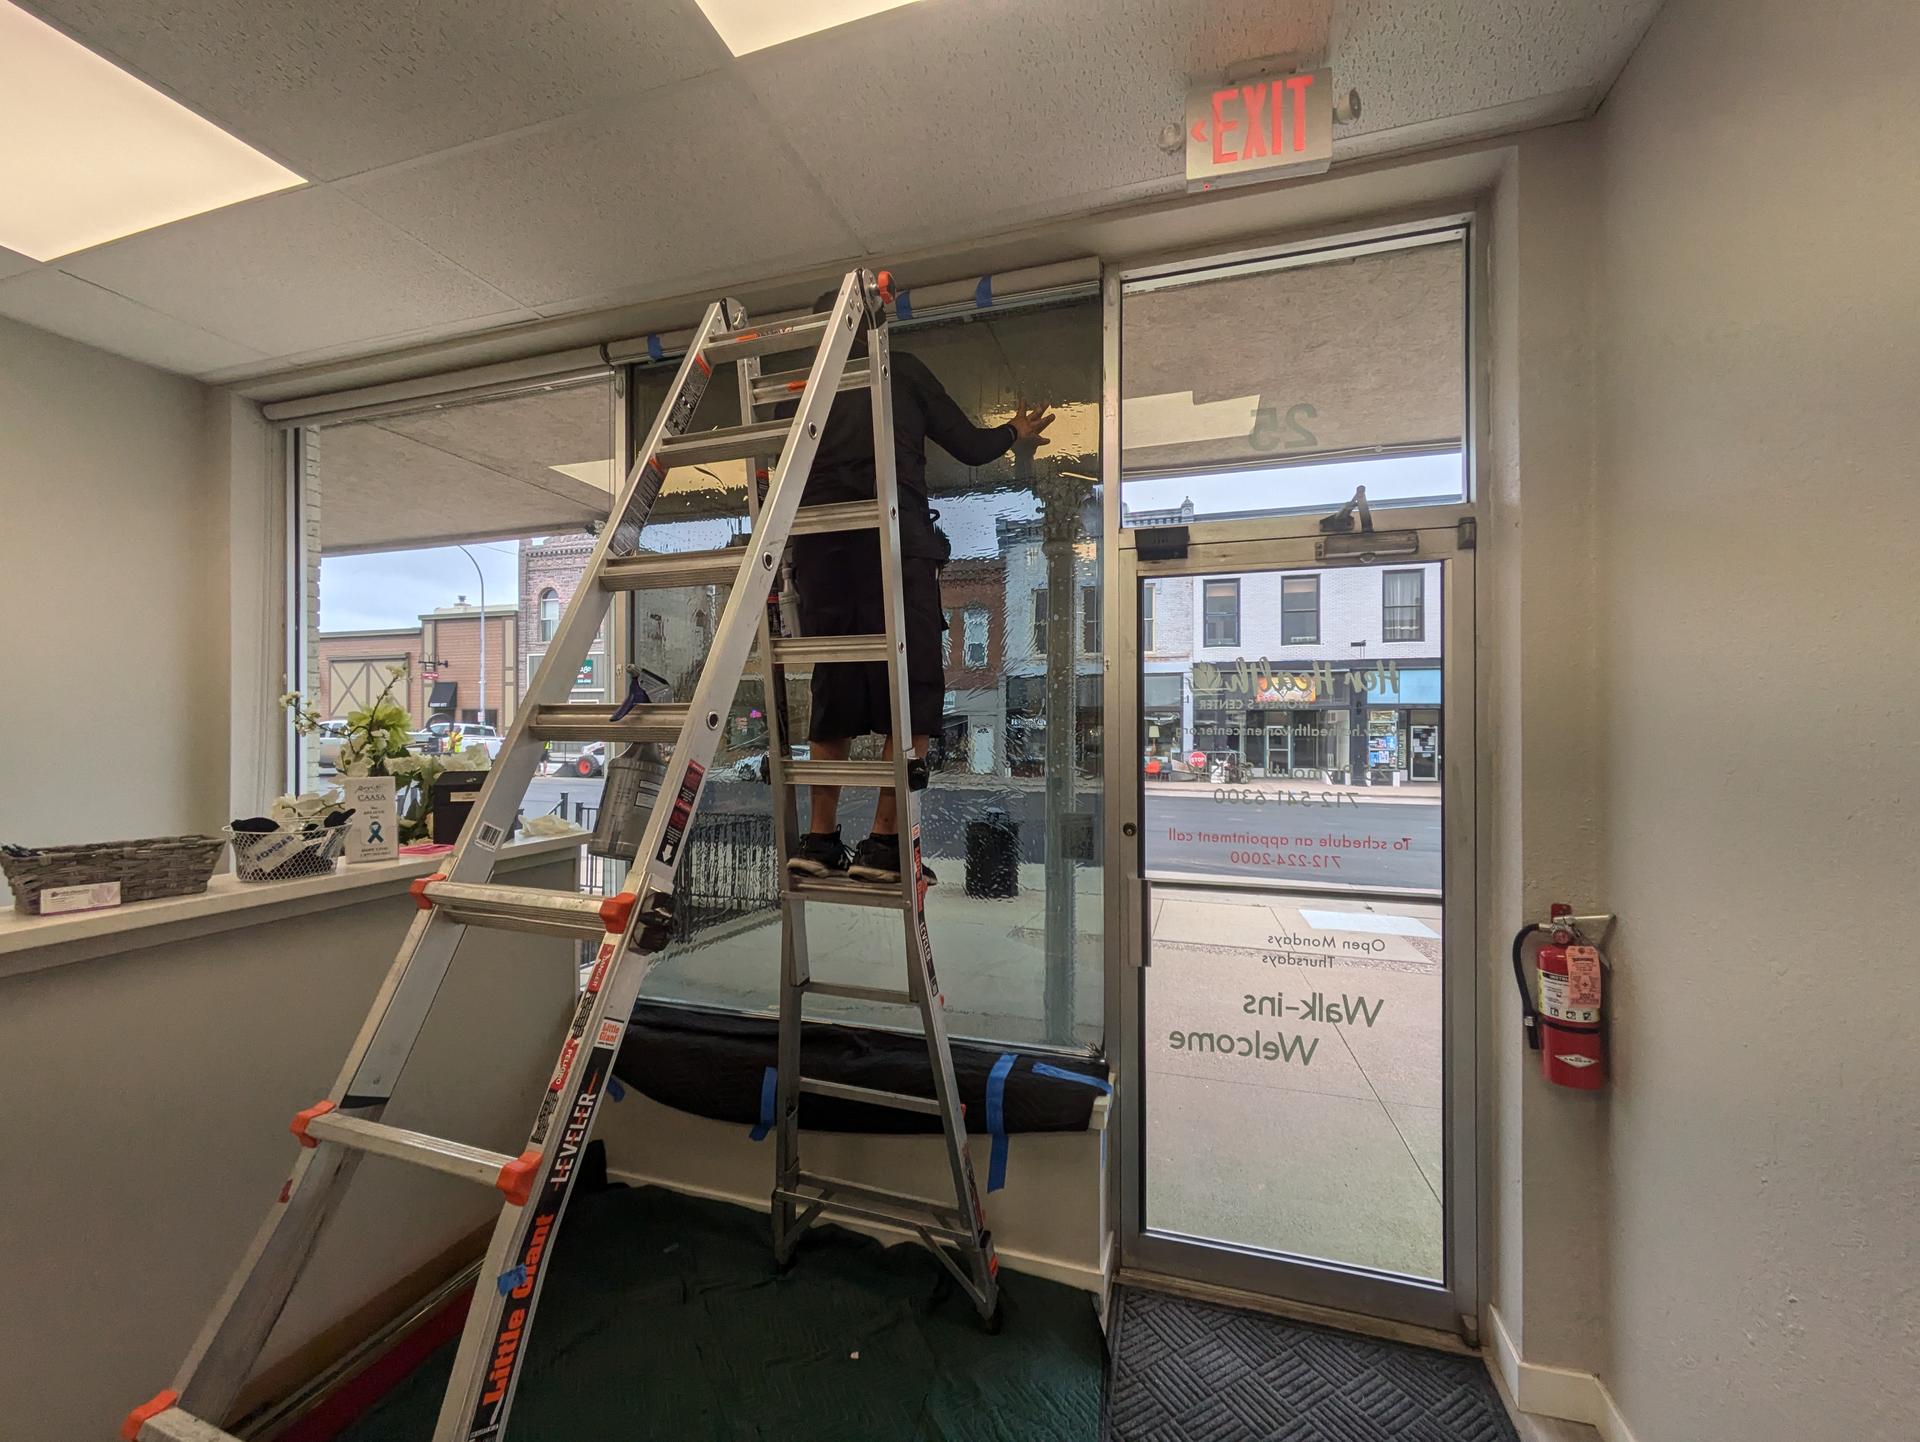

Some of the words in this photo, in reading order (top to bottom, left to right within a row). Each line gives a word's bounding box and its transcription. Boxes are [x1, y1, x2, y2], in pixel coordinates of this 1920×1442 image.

[1212, 75, 1314, 165] EXIT
[920, 922, 931, 961] LEVELER
[599, 1031, 617, 1043] Giant
[602, 1021, 620, 1034] Little
[555, 1048, 573, 1085] PELIGRO
[483, 1308, 526, 1406] Little
[550, 1092, 598, 1184] LEVELER
